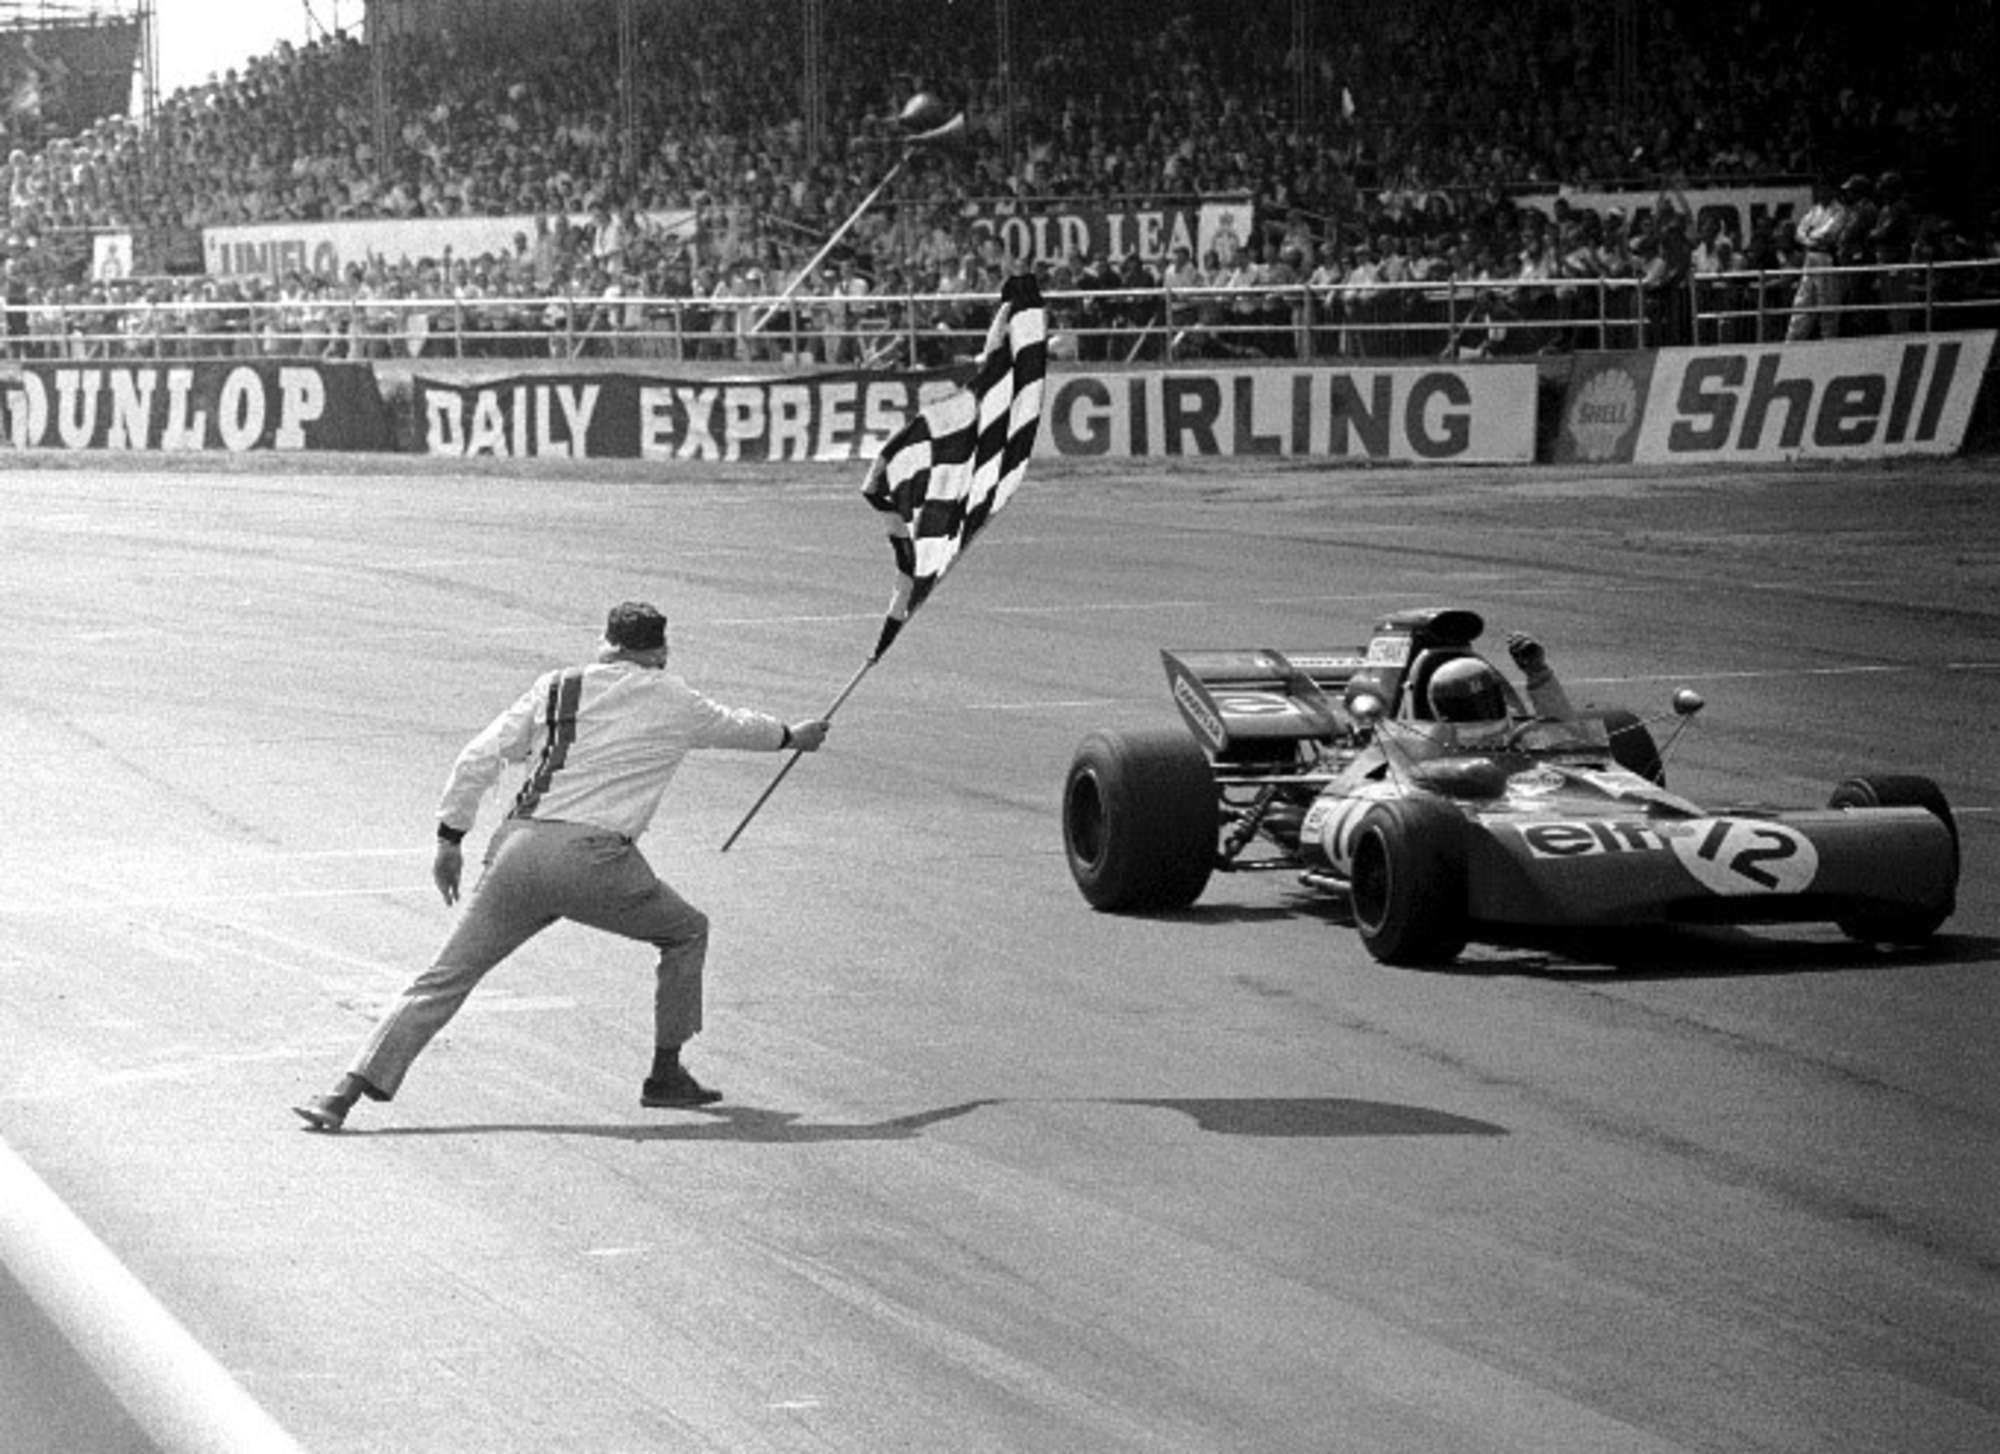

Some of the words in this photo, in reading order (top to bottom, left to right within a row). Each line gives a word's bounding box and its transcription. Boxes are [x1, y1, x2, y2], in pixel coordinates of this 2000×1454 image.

[1106, 210, 1203, 264] LEA
[6, 367, 324, 450] DUNLOP
[425, 384, 600, 458] DAILY
[640, 381, 958, 461] EXPRES
[1052, 374, 1472, 459] GIRLING
[1667, 343, 1962, 452] Shell
[1524, 821, 1654, 856] elf
[1697, 820, 1797, 891] 12
